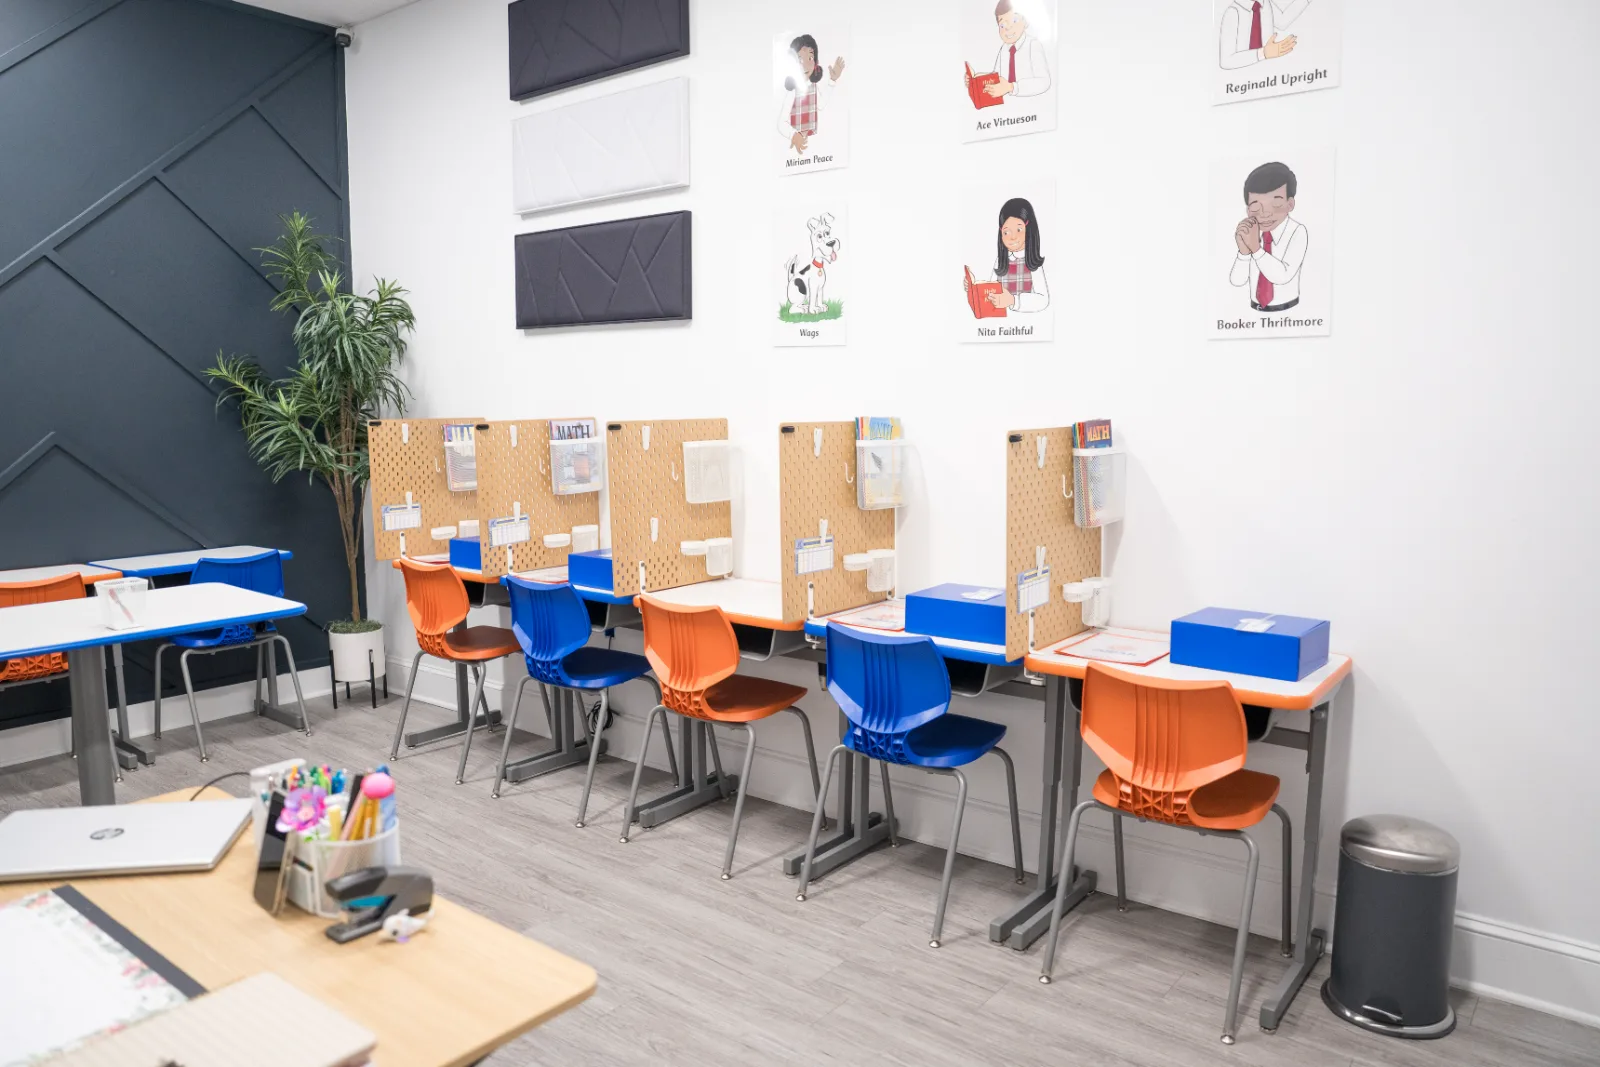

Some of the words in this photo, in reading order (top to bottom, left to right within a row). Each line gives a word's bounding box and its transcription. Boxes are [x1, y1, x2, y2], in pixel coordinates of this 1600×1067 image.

[1226, 76, 1277, 94] Reginald
[1281, 69, 1327, 86] Upright
[976, 121, 992, 131] Ace
[993, 114, 1037, 127] Virtueson
[785, 157, 811, 168] Miriam
[813, 154, 834, 164] Peace
[977, 327, 996, 336] Nita
[999, 325, 1034, 336] Faithful
[1217, 318, 1256, 330] Booker
[1260, 317, 1323, 328] Thriftmore
[799, 328, 820, 340] Wags
[556, 424, 591, 440] MATH
